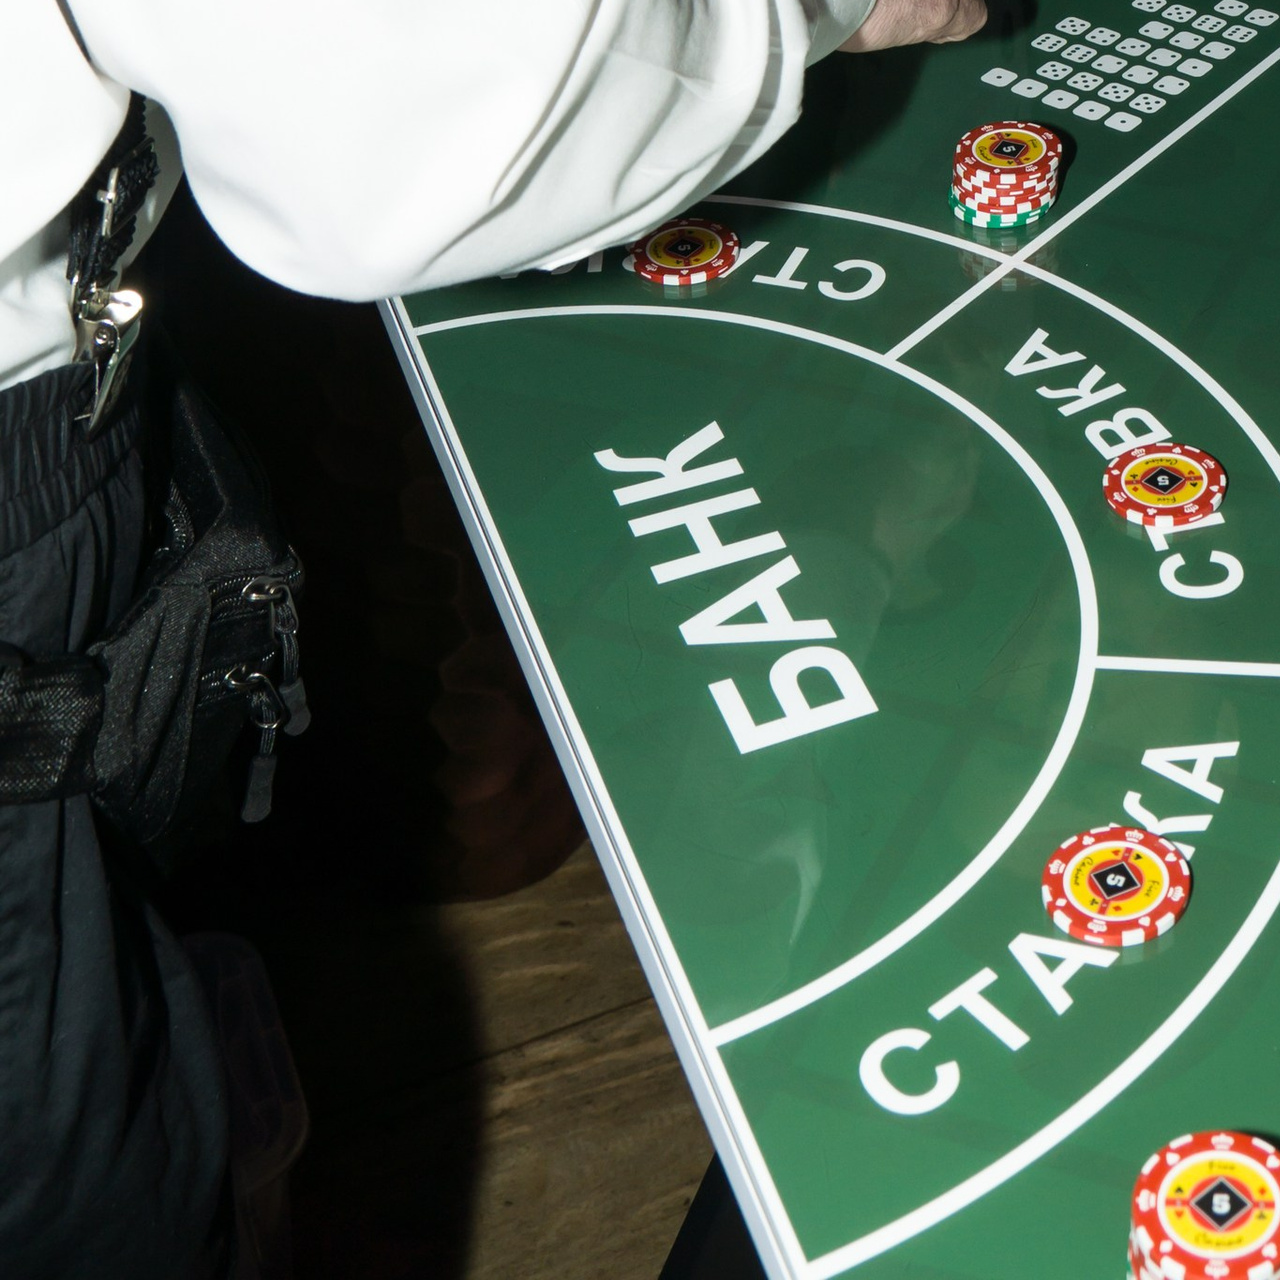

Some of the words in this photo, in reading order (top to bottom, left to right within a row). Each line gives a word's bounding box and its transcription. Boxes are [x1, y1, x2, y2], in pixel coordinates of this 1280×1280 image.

[1002, 145, 1016, 153] 5
[1004, 327, 1245, 599] СТВКА
[1157, 475, 1169, 485] 5
[593, 420, 879, 755] БАНК
[1106, 873, 1126, 887] 5
[859, 741, 1240, 1115] СТАКА
[1211, 1192, 1231, 1215] 5
